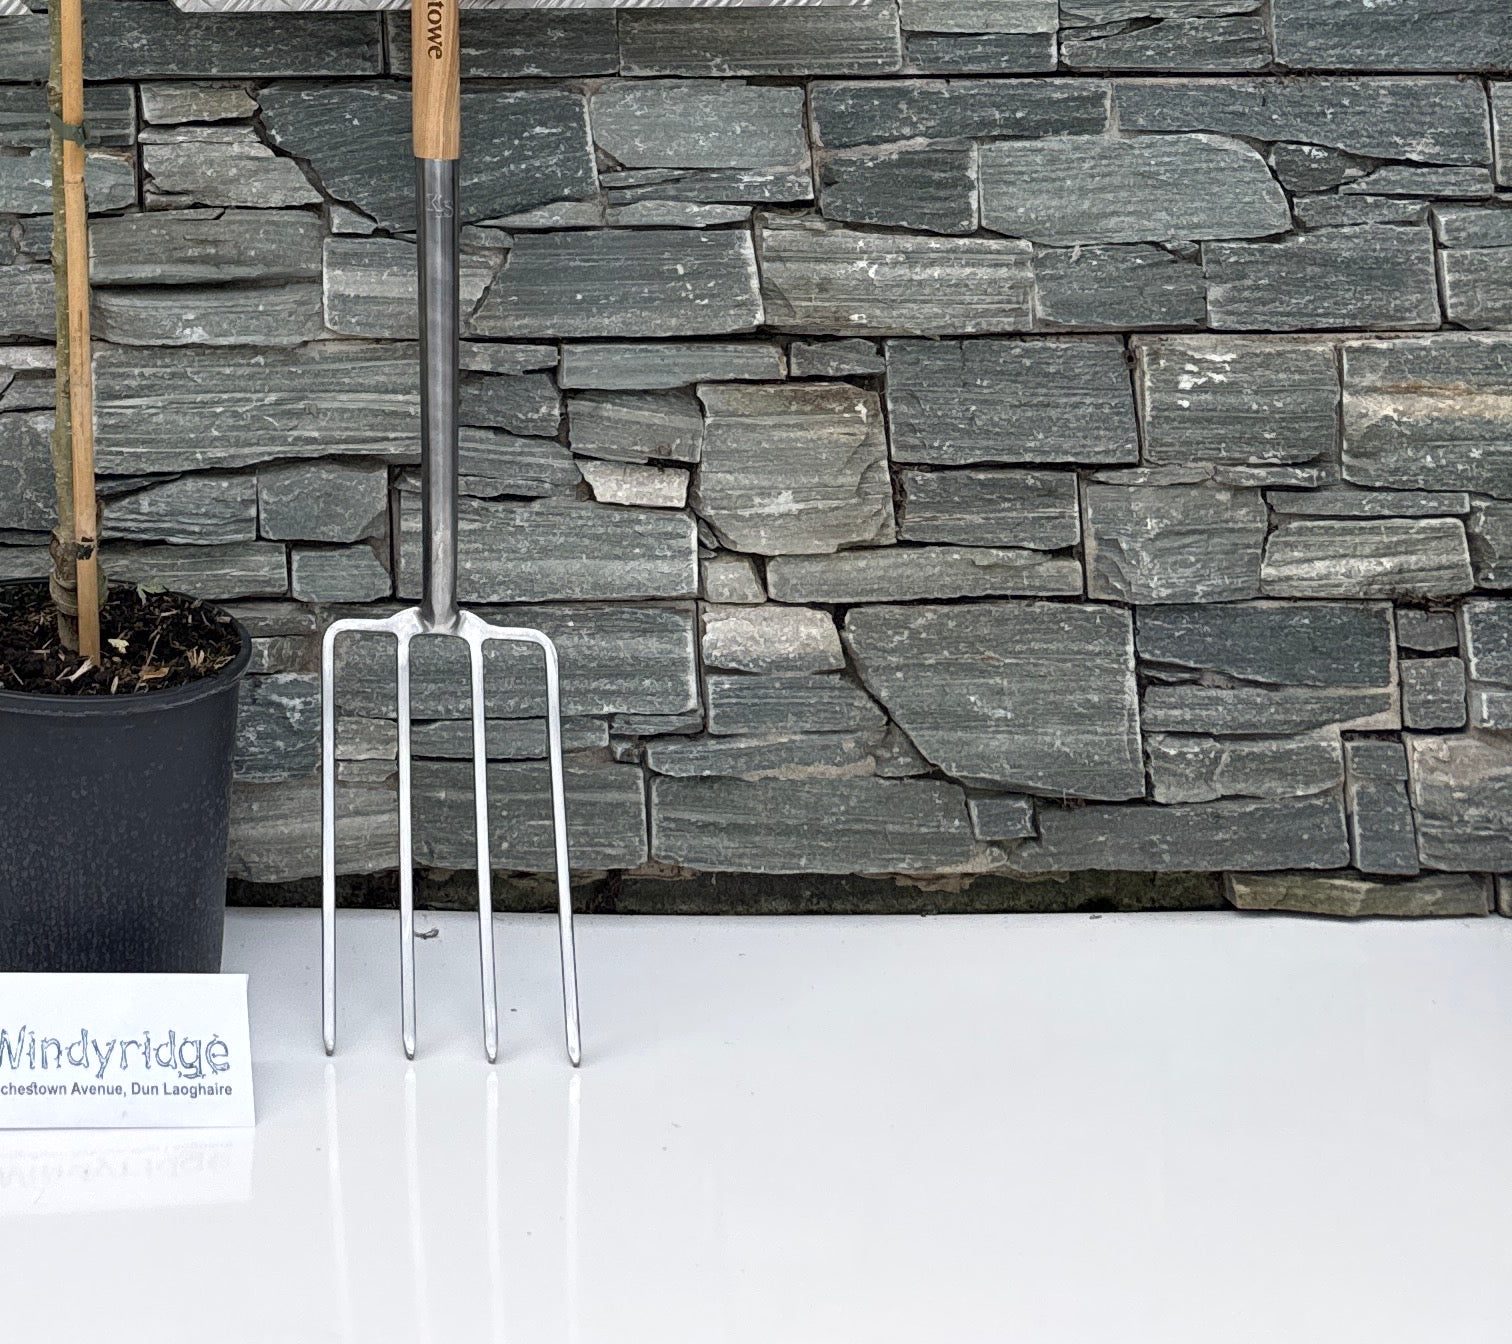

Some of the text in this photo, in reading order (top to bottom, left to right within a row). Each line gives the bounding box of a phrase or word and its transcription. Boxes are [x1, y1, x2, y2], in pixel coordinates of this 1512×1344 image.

[71, 1081, 127, 1098] Avenue,
[131, 1081, 159, 1096] Dun
[163, 1081, 233, 1099] Laoghaire
